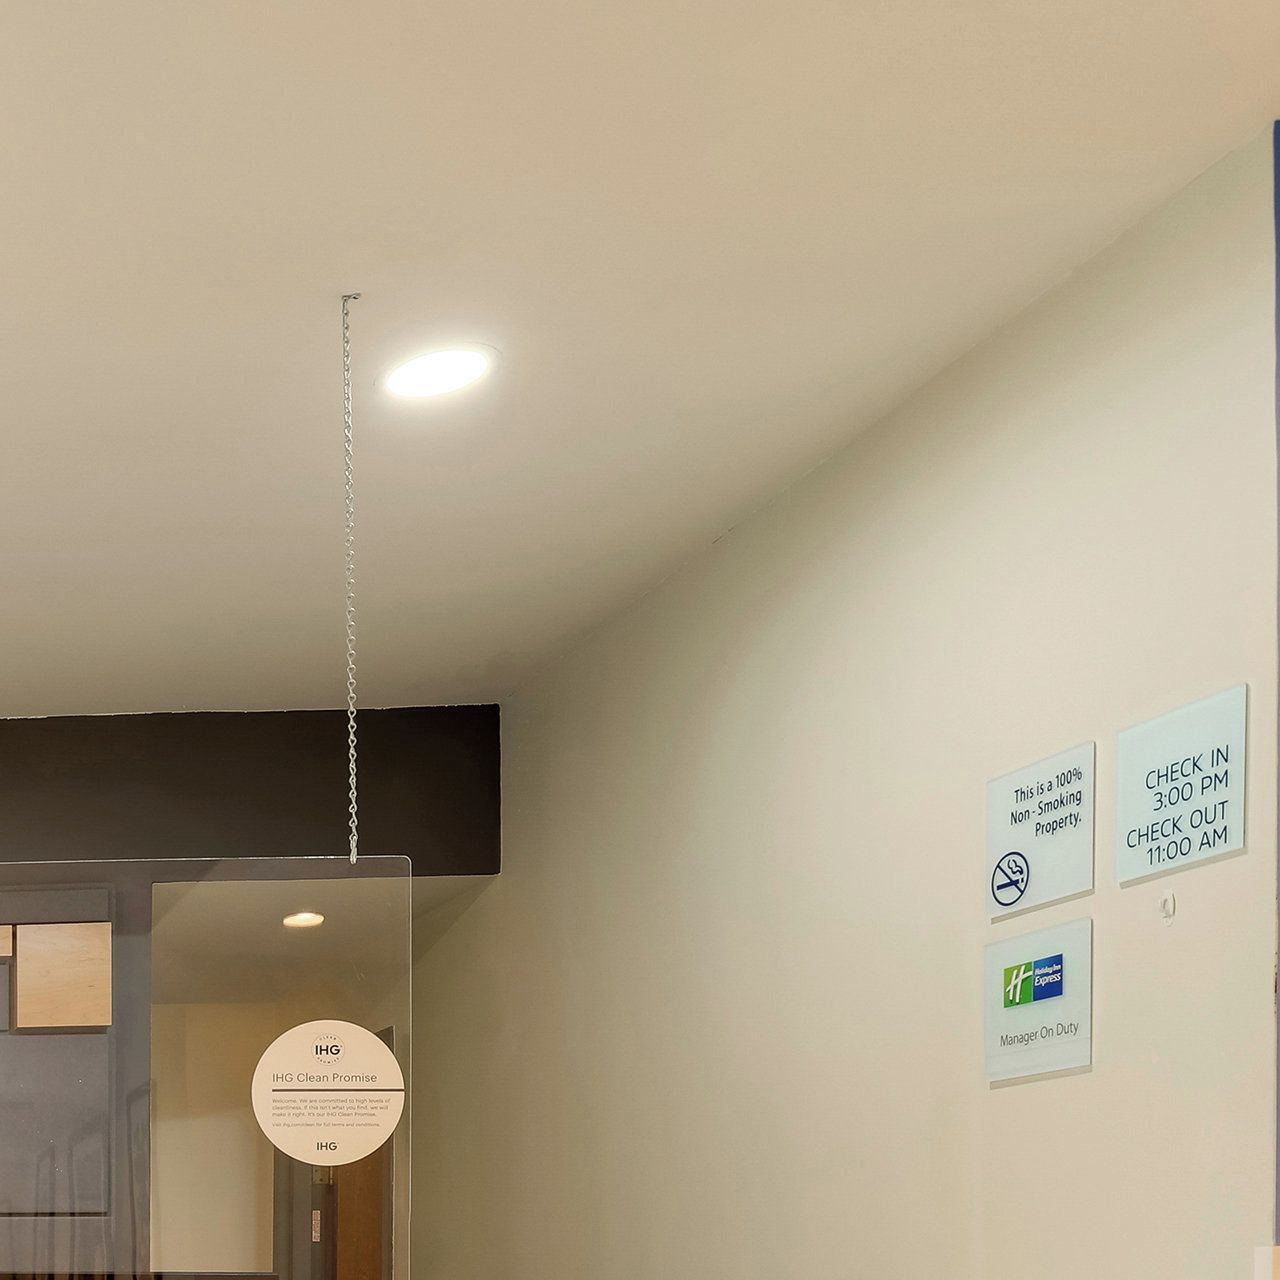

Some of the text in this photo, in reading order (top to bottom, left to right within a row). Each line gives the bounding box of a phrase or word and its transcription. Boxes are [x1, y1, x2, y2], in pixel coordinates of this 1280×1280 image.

[1145, 744, 1229, 789] CHECK IN
[1014, 766, 1082, 804] This is a 100%
[1153, 769, 1228, 811] 3:00 PM
[1010, 809, 1030, 826] Non
[1037, 790, 1082, 816] Smoking
[1035, 812, 1082, 837] Property.
[1126, 800, 1229, 848] CHECK OUT
[1147, 825, 1227, 865] 11:00 AM
[1034, 972, 1061, 986] Express
[1000, 1022, 1079, 1046] Manager On Duty
[315, 1045, 341, 1055] IHG
[272, 1072, 378, 1083] IHG Clean Promise
[316, 1142, 337, 1151] IHG
